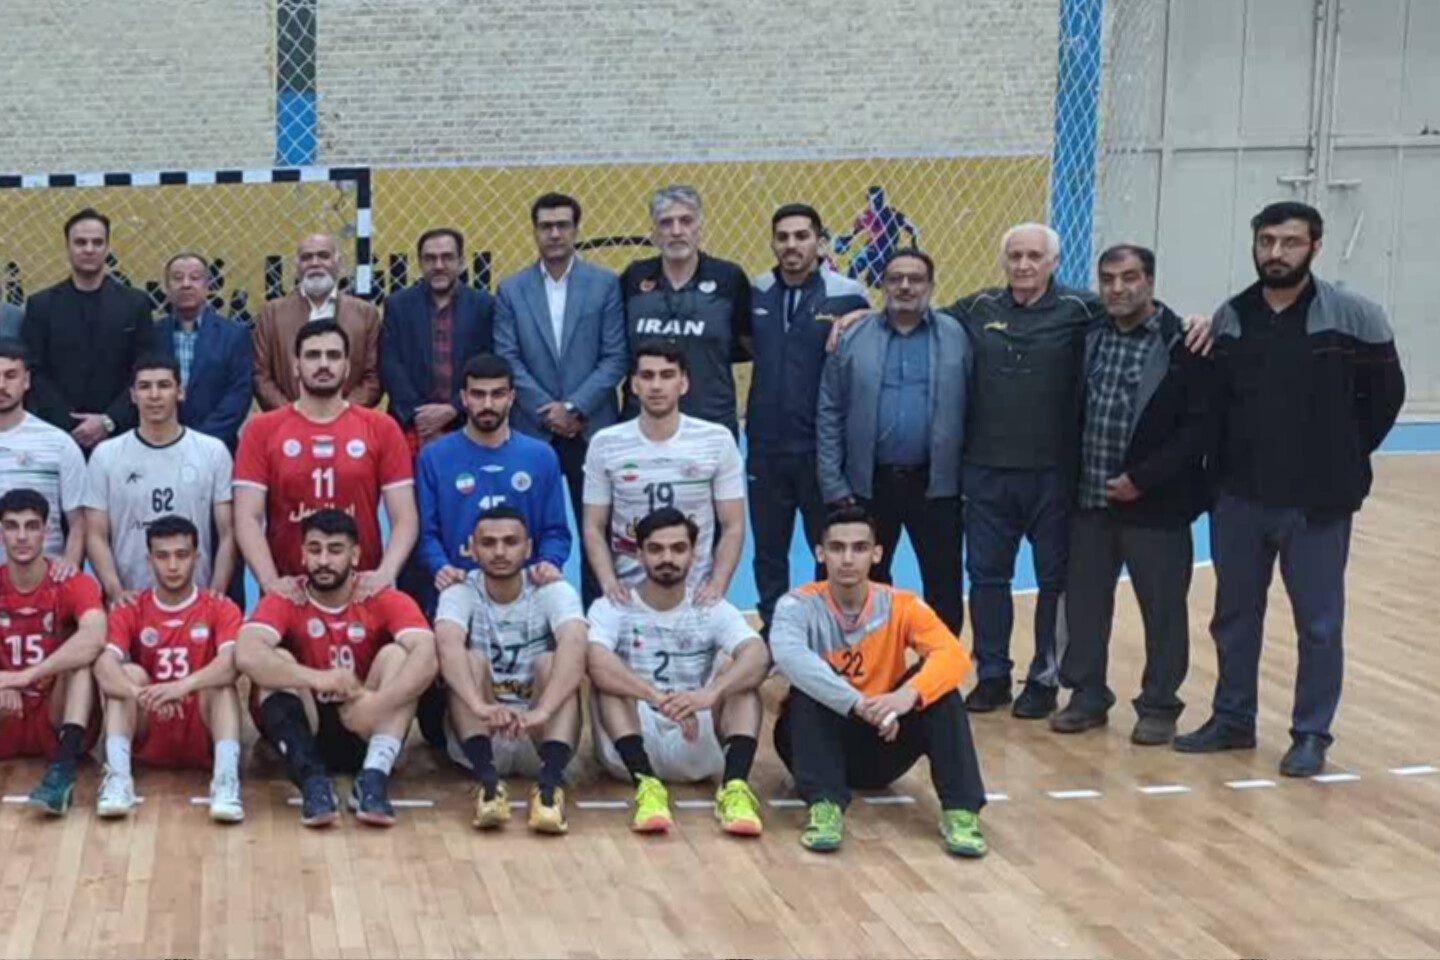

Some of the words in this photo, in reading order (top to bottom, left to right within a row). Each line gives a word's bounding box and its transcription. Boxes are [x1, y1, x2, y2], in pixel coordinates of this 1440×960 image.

[636, 318, 705, 336] IRAN
[312, 467, 335, 498] 11
[643, 482, 675, 512] 19
[152, 487, 174, 512] 62
[4, 634, 44, 665] 15
[157, 647, 189, 679] 33
[491, 644, 519, 673] 27
[842, 651, 864, 677] 22
[653, 651, 669, 682] 2
